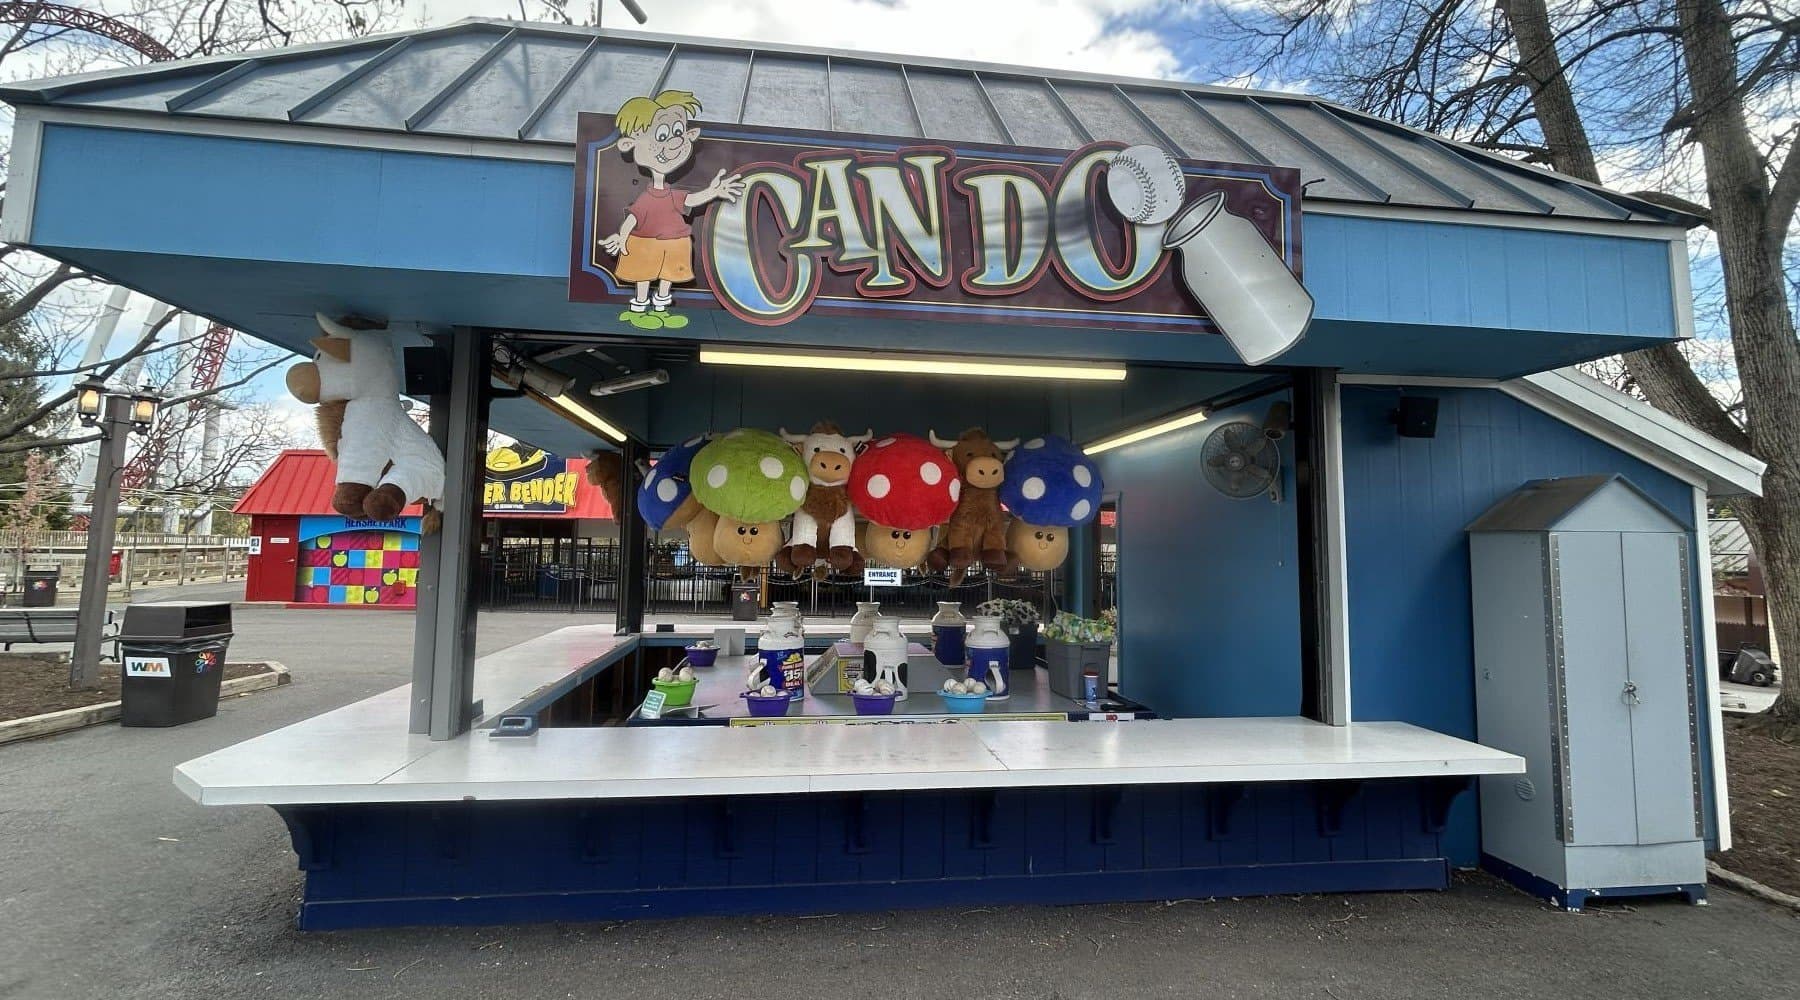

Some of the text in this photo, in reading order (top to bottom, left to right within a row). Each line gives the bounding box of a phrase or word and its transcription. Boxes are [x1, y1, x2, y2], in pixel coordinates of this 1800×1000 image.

[703, 142, 1172, 324] CAN DO
[510, 472, 579, 507] BENDER
[131, 661, 165, 672] WM
